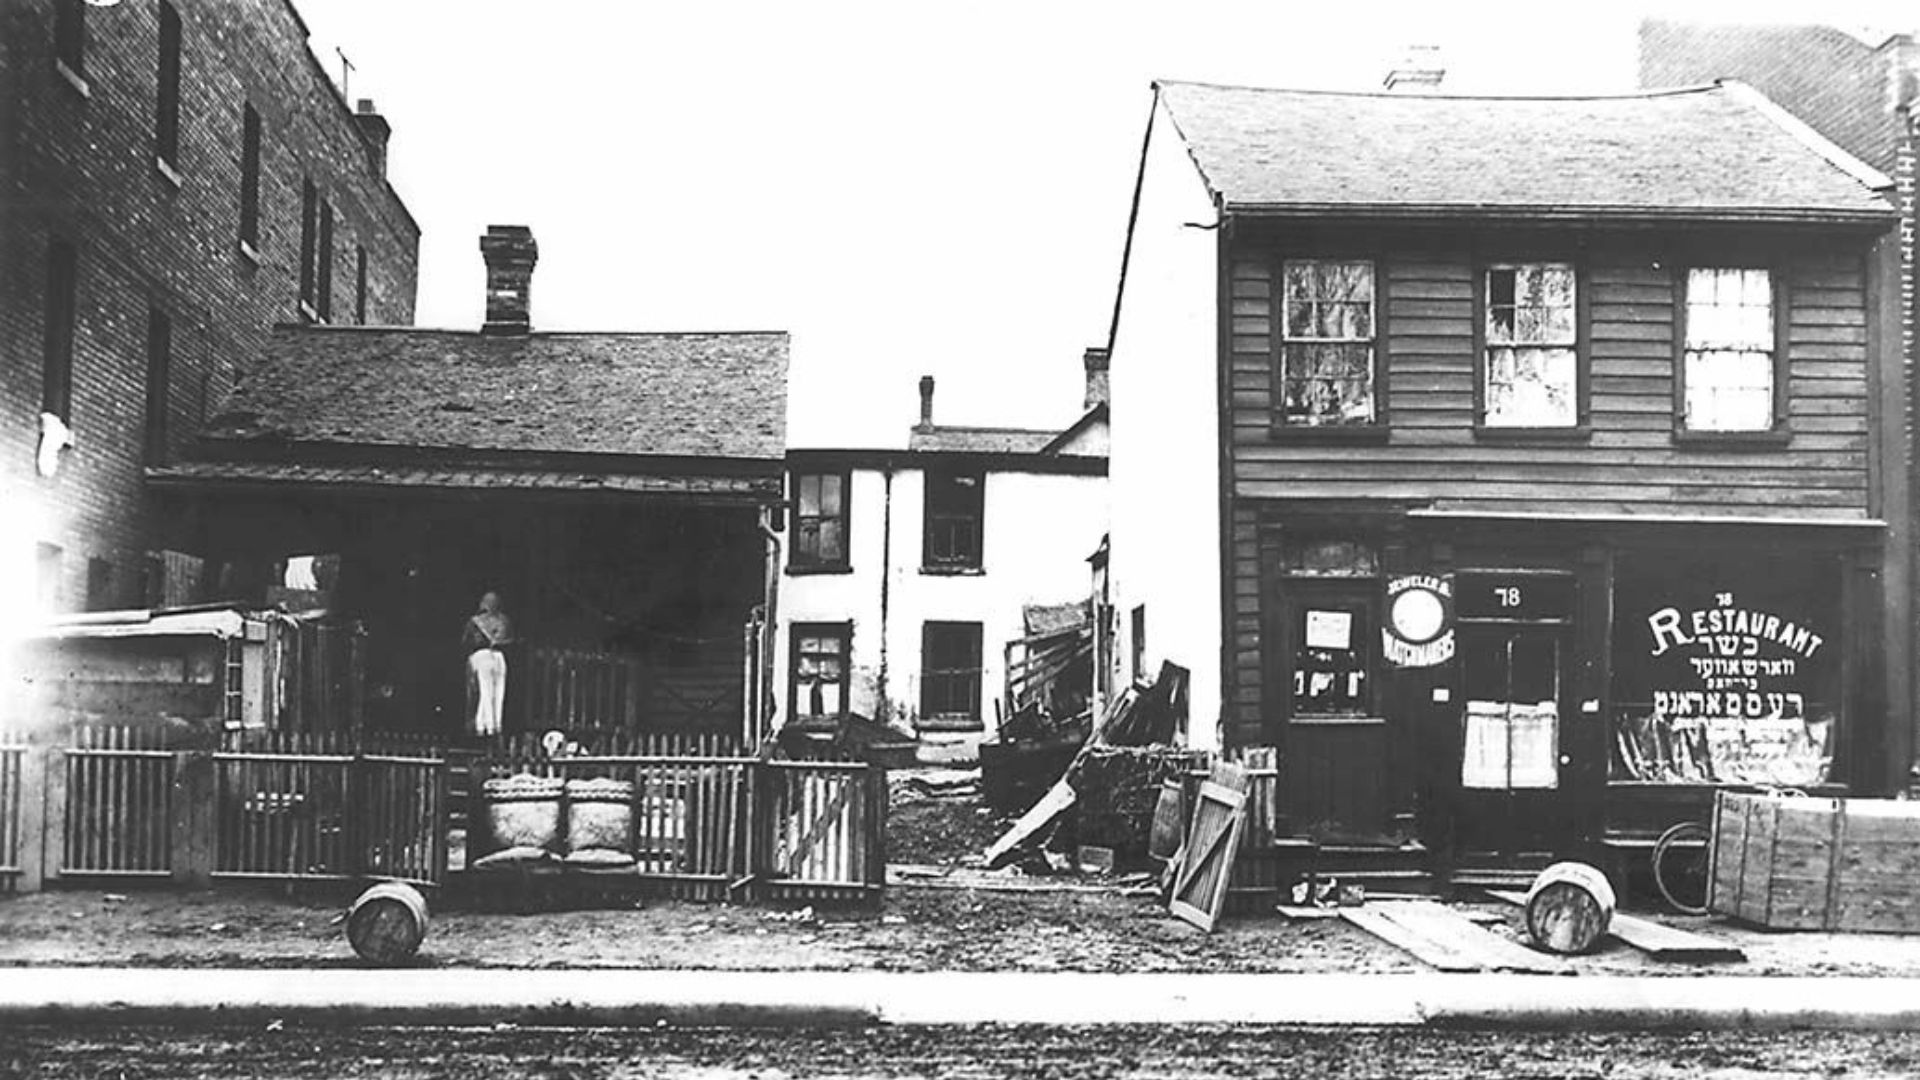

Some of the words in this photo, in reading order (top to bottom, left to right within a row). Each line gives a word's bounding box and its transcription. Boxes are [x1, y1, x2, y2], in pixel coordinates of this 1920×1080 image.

[1494, 587, 1521, 607] 78
[1715, 592, 1733, 607] 78
[1648, 607, 1823, 658] RESTAURANT
[1698, 634, 1759, 656] כשר
